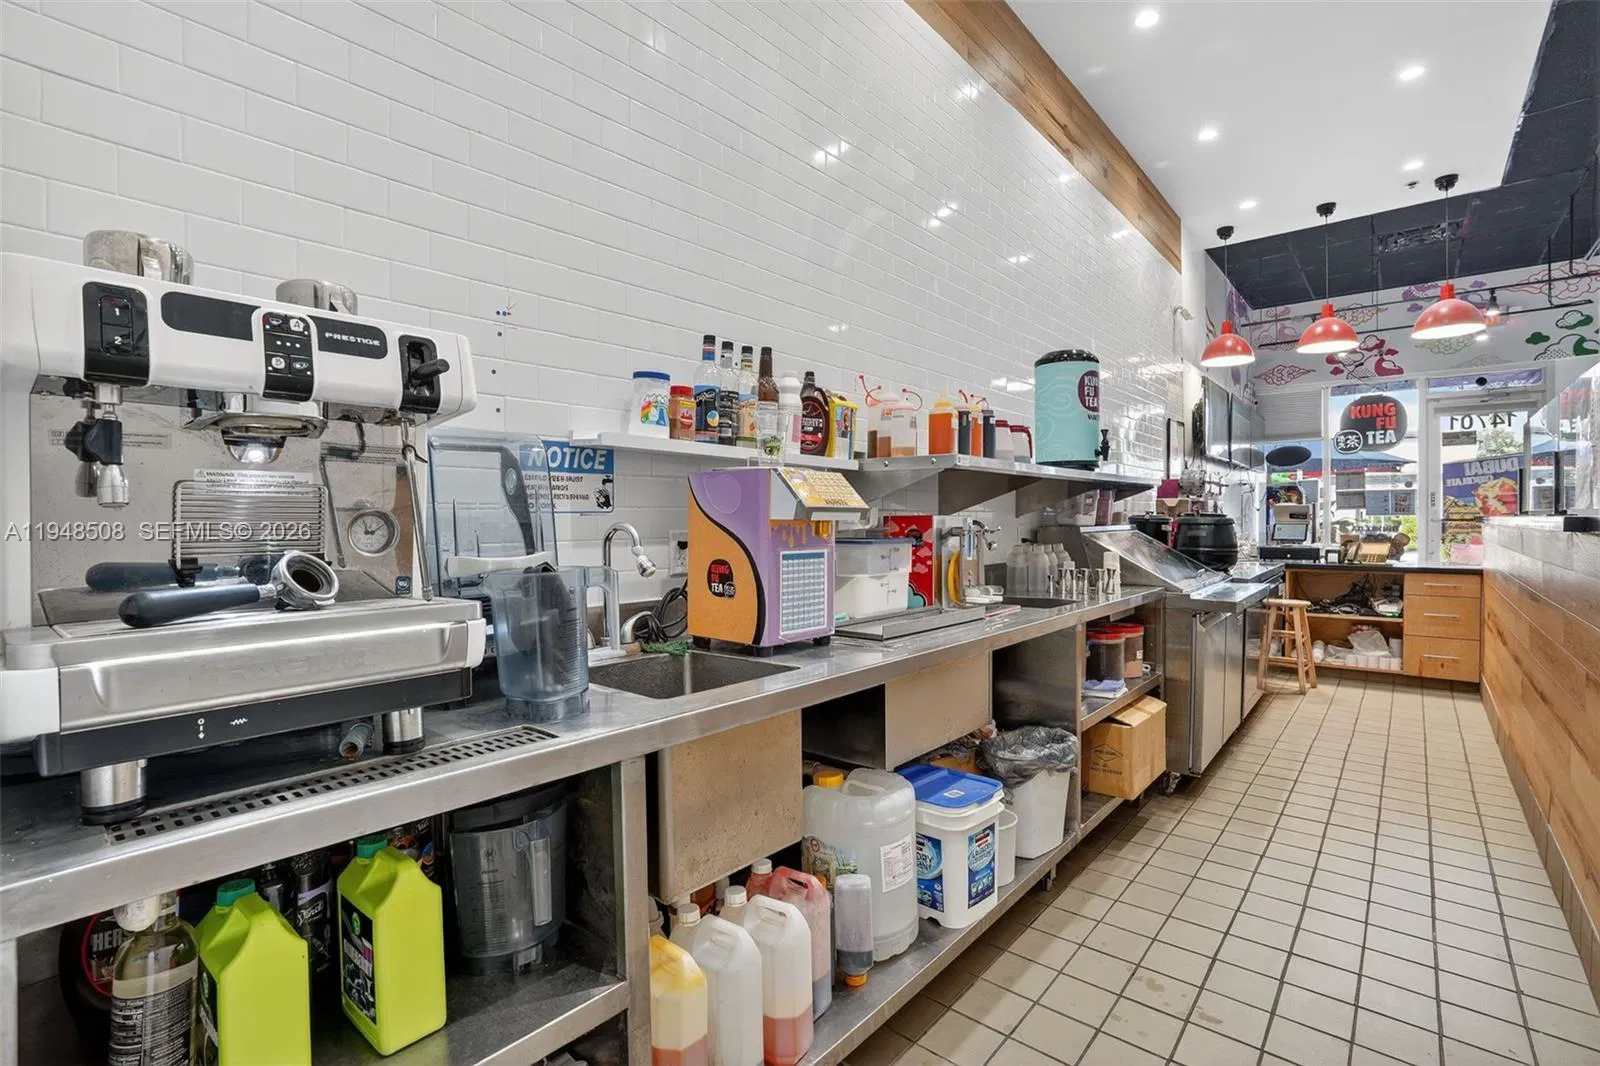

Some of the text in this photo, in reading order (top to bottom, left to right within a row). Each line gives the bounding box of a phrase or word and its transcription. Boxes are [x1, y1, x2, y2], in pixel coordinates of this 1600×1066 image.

[114, 307, 120, 316] 1
[114, 336, 122, 345] 2
[324, 332, 381, 346] PRESTIGE
[1084, 386, 1095, 396] FU
[1350, 402, 1397, 419] KUNG
[1376, 415, 1397, 430] FU
[1366, 430, 1398, 445] TEA
[527, 446, 608, 470] NOTICE
[711, 583, 723, 593] TEA
